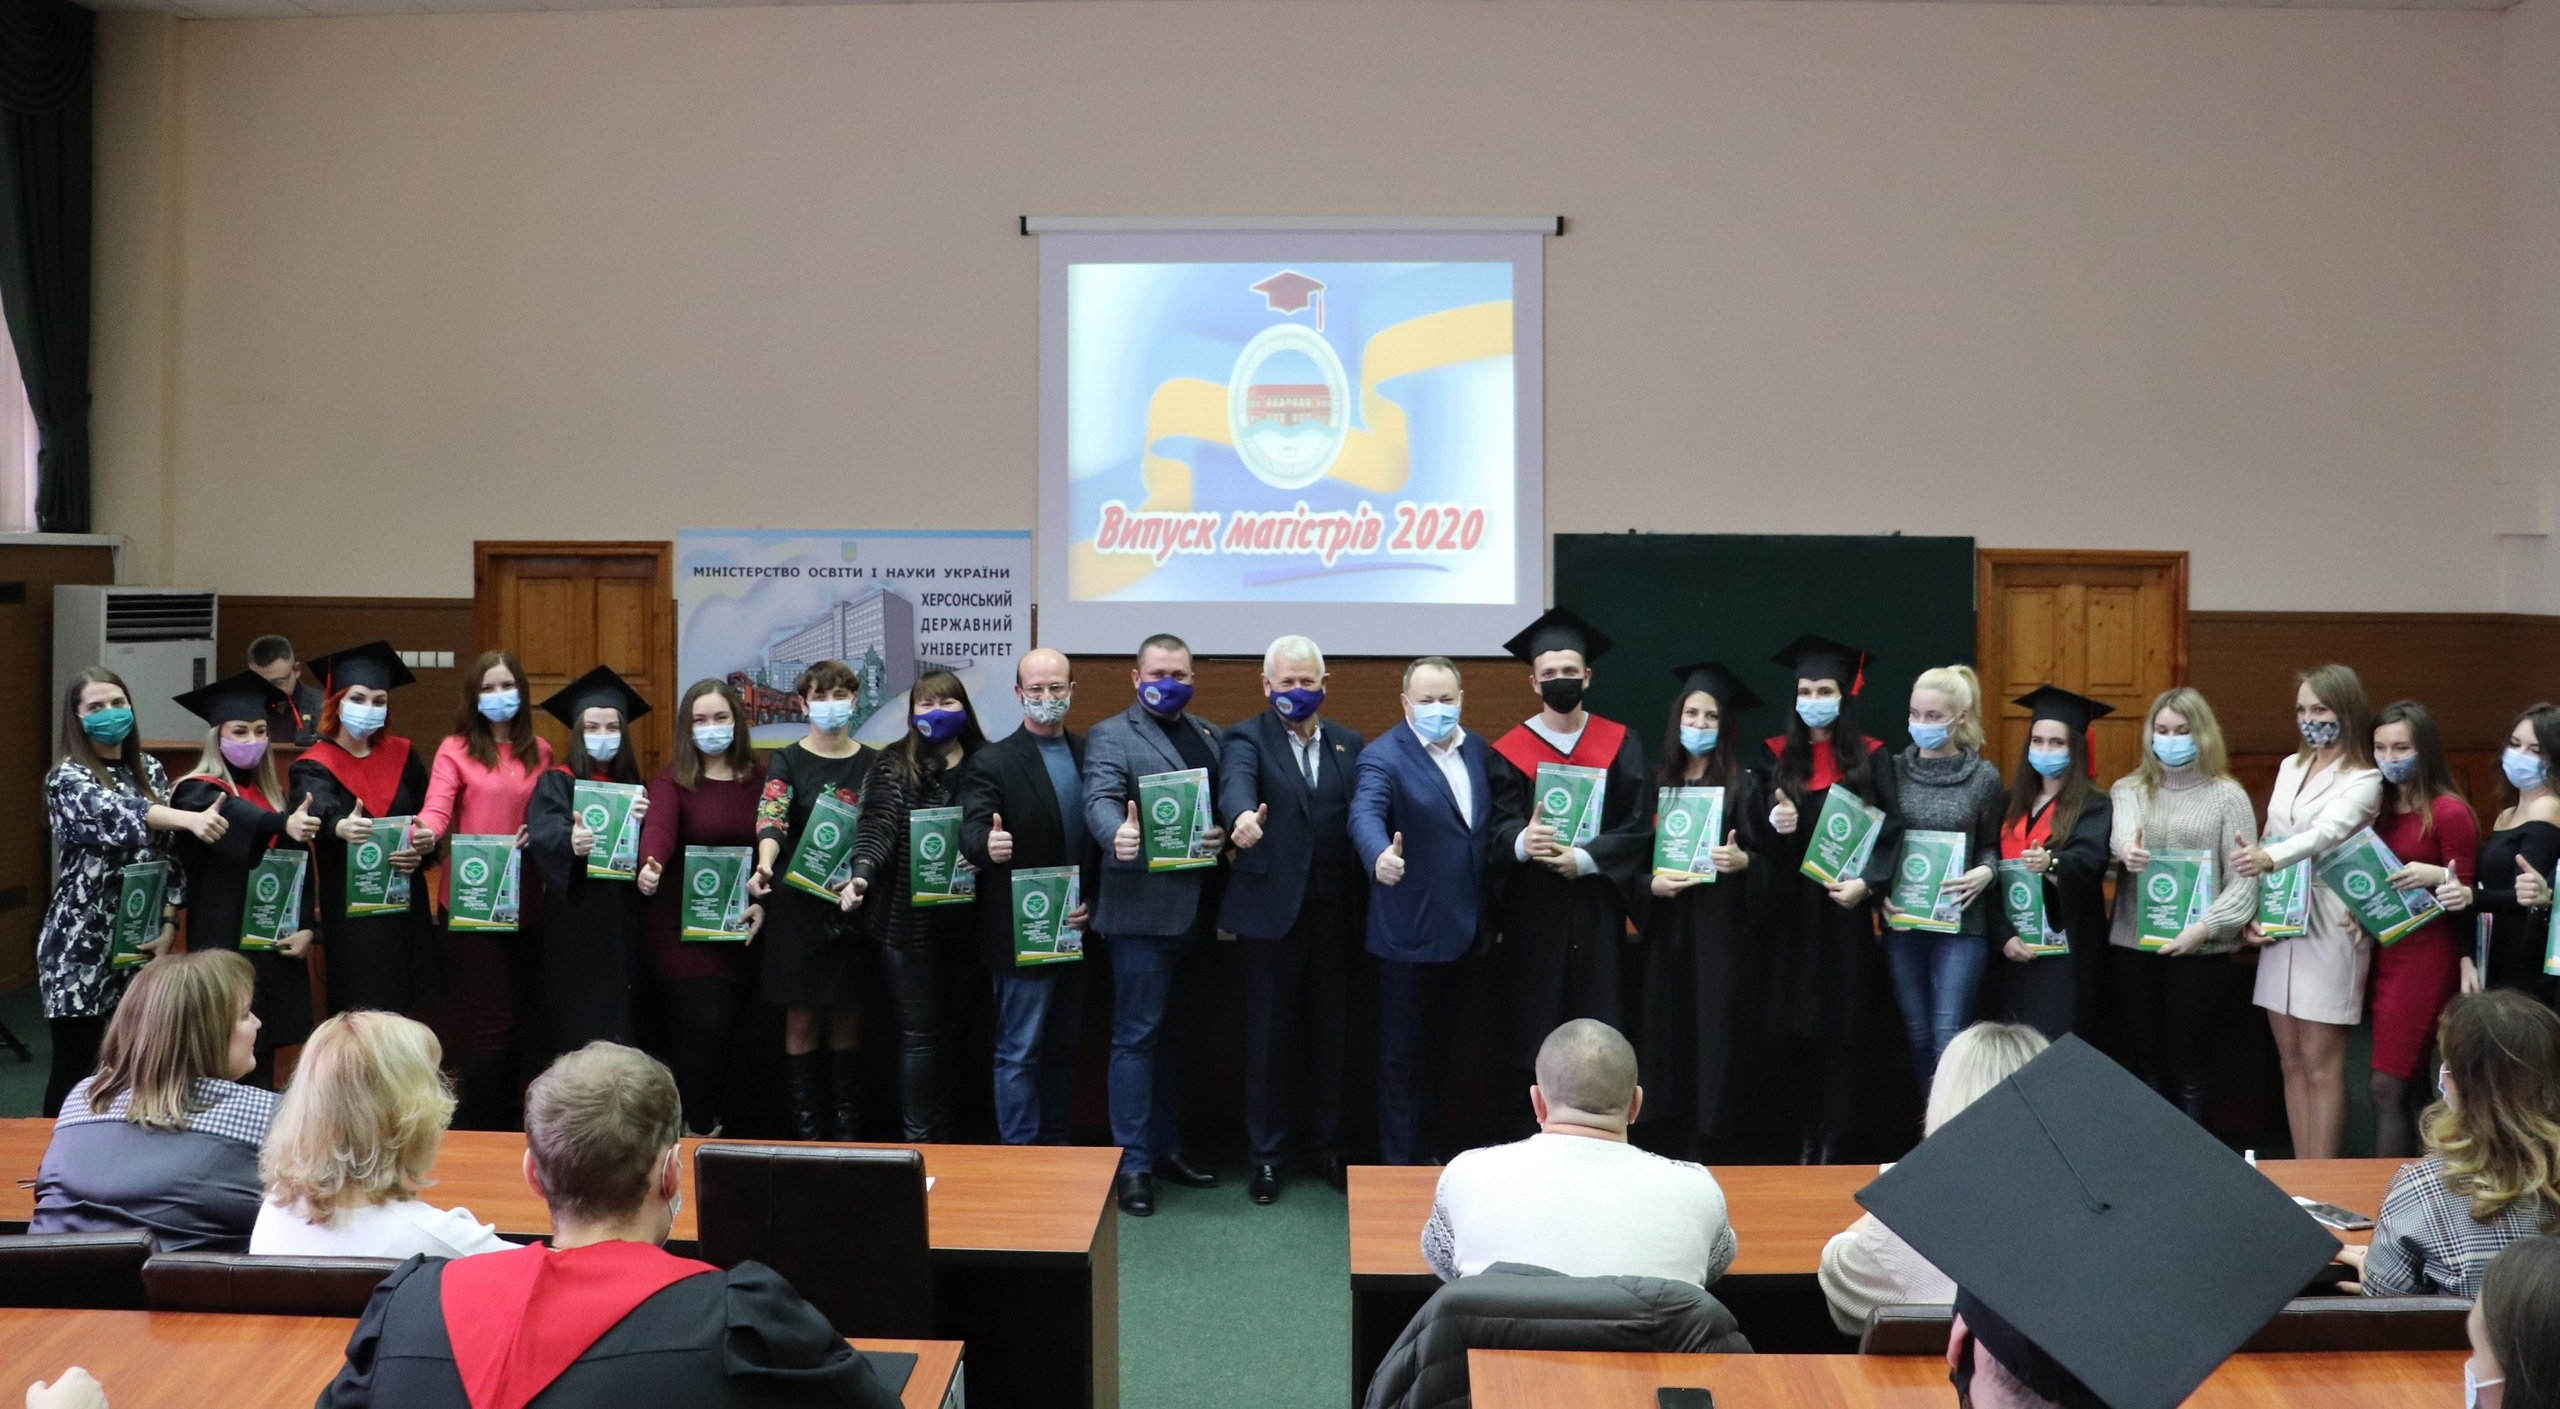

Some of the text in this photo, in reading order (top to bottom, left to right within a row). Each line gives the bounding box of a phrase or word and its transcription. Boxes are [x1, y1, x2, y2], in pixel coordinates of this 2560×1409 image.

[1097, 505, 1484, 563] Випуск магістрів 2020
[693, 565, 1010, 579] МІНІСТЕРСТВО ОСВІТИ І НАУКИ УКРАЇНИ
[921, 589, 1012, 607] ХЕРСОНСЬКИЙ
[921, 614, 1012, 634] ДЕРЖАВНИЙ
[921, 642, 1012, 656] УНІВЕРСИТЕТ
